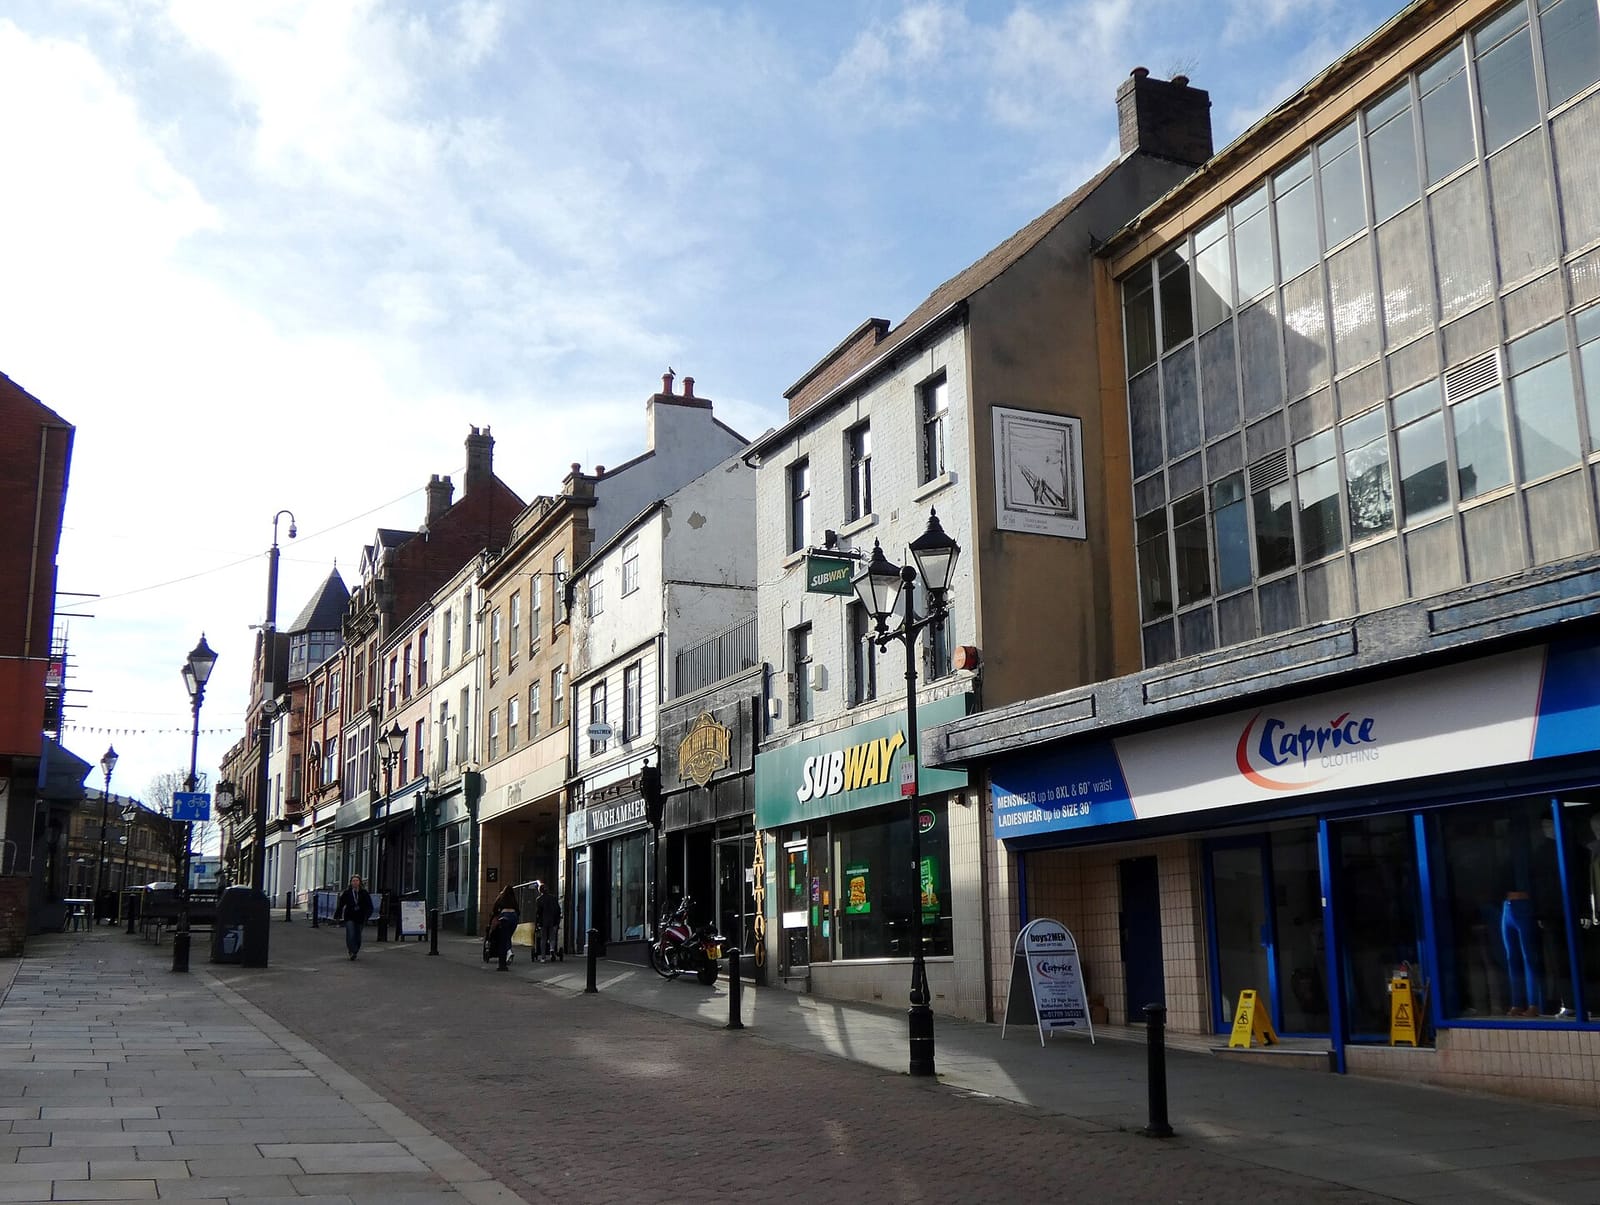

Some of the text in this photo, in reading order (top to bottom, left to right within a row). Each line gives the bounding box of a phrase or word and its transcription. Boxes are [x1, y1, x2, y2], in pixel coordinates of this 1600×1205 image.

[811, 567, 849, 587] SUBWAY
[1259, 713, 1377, 768] Caprice
[797, 728, 905, 804] SUBWAY
[1321, 748, 1380, 768] CLOTHING
[997, 791, 1037, 809] MENSWEAR
[1037, 792, 1047, 804] up
[1047, 790, 1055, 801] to
[1055, 787, 1070, 800] 8XL
[1071, 786, 1078, 797] &
[1092, 779, 1113, 793] waist
[592, 798, 646, 831] WARHAMMER
[998, 810, 1043, 828] LADIESWEAR
[1043, 810, 1053, 823] up
[1053, 808, 1061, 819] to
[1062, 803, 1078, 818] SIZE
